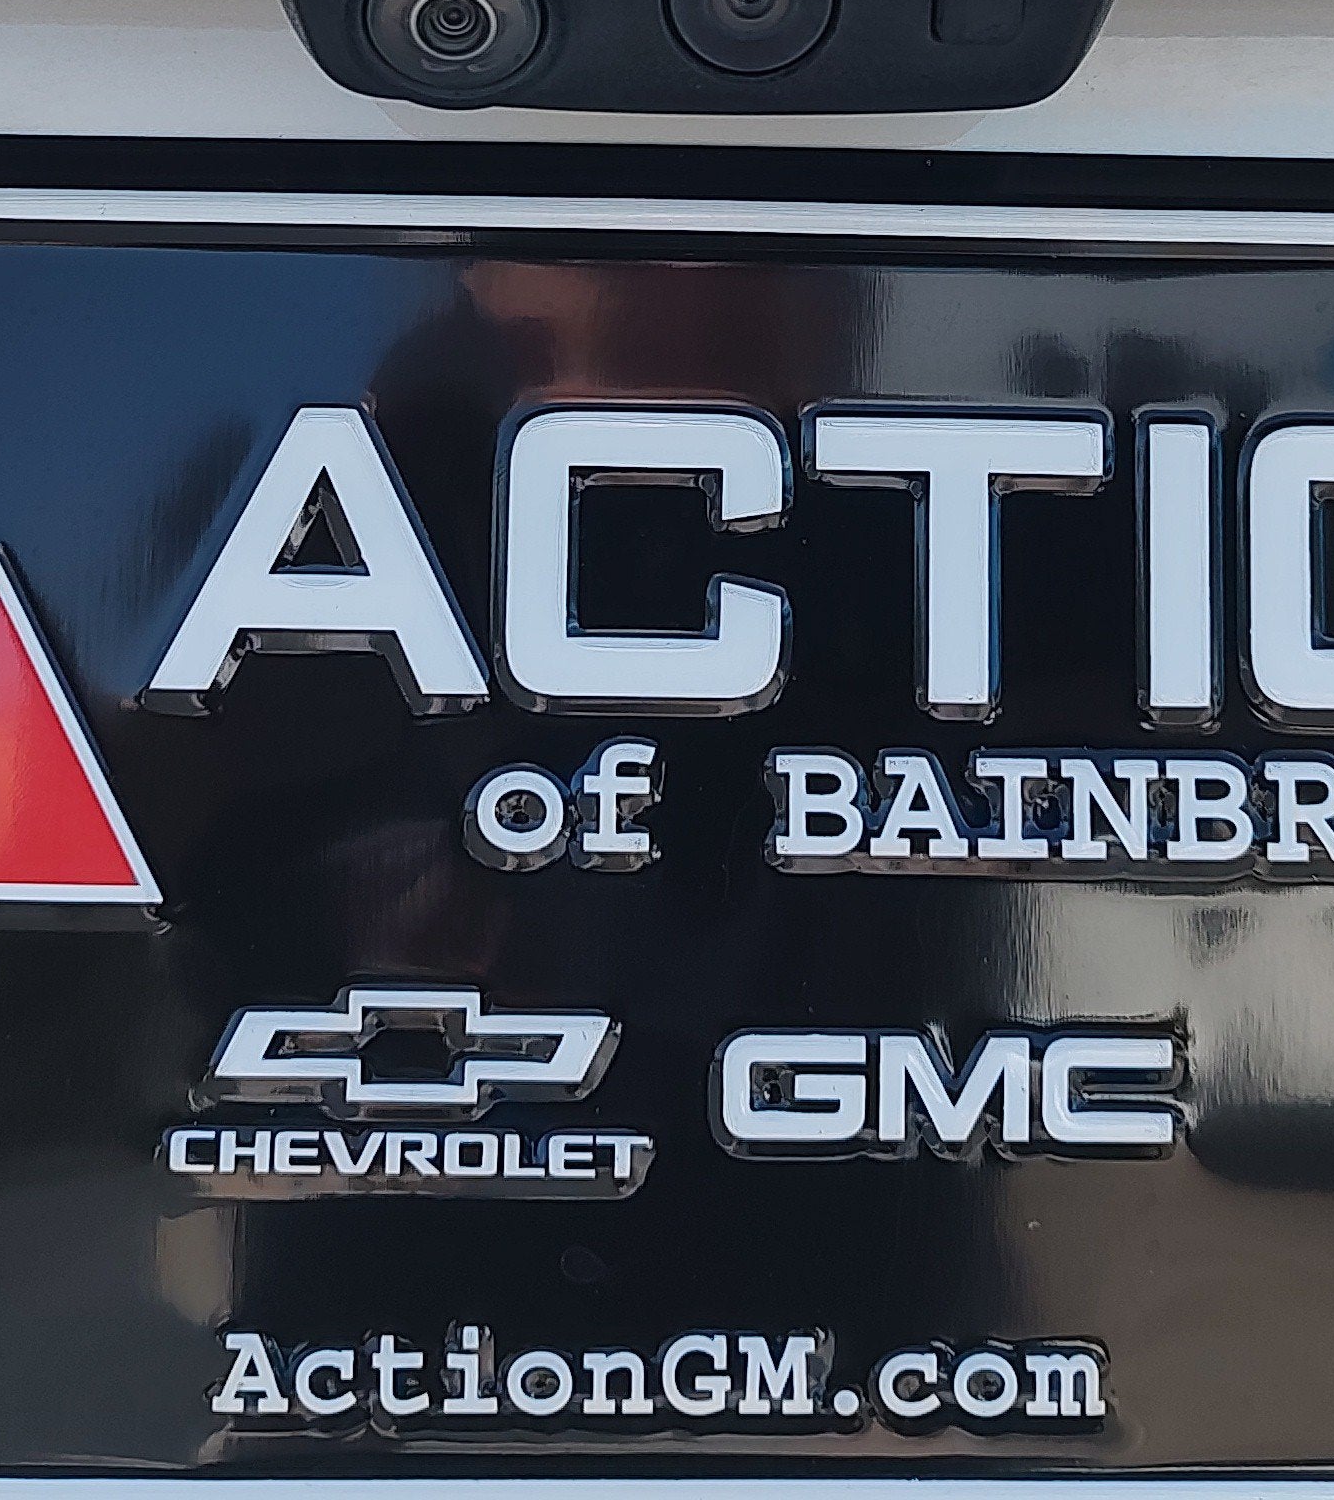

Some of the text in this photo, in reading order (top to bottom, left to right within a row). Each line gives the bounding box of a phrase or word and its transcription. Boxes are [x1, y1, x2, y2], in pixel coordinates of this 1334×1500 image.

[467, 740, 659, 862] of
[719, 1030, 1179, 1150] GMC
[168, 1128, 646, 1182] CHEVROLET
[212, 1324, 1107, 1419] ActionGM.com
